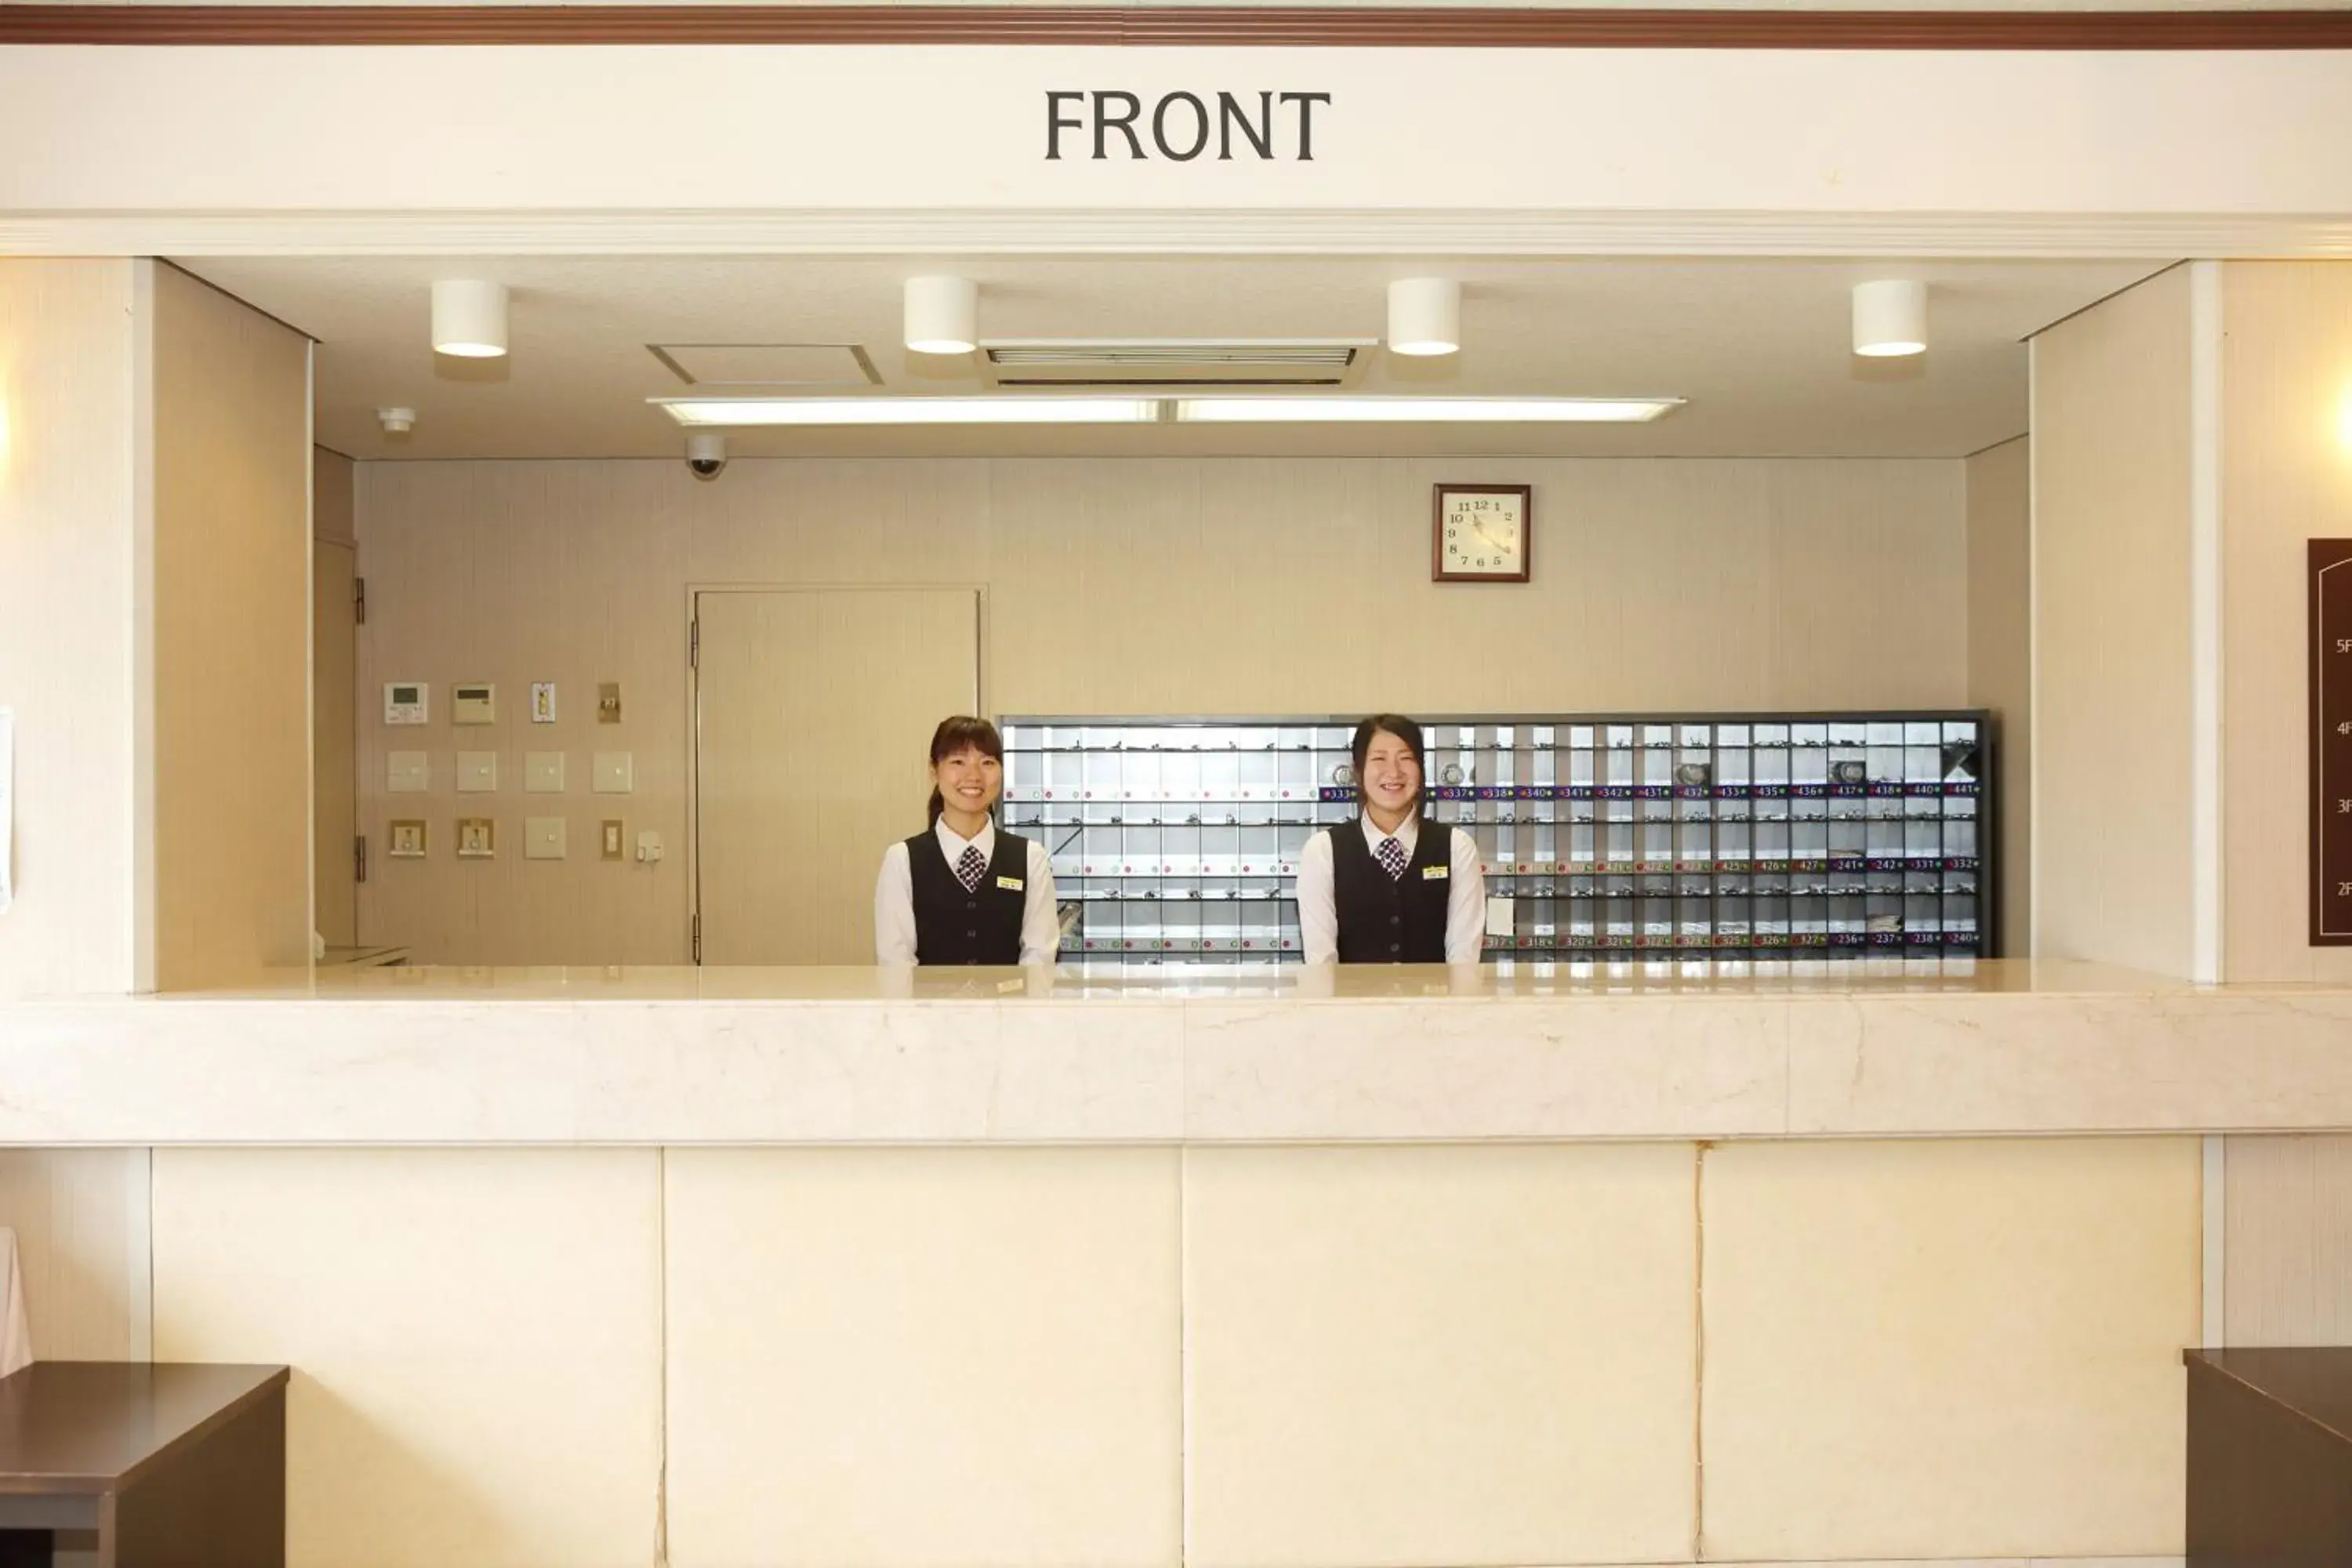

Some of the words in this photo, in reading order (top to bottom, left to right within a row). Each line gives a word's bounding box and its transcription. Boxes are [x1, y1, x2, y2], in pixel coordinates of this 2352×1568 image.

[1044, 90, 1331, 162] FRONT
[1458, 502, 1471, 511] 11
[1474, 500, 1488, 510] 12
[1494, 502, 1500, 511] 1
[1450, 514, 1463, 524] 10
[1461, 556, 1468, 565] 7
[1494, 556, 1502, 565] 5
[2336, 639, 2352, 653] 5F
[2337, 721, 2352, 735] 4F
[1448, 789, 1467, 797] 337
[1488, 789, 1507, 797] 338
[1527, 789, 1546, 797] 340
[1565, 788, 1583, 797] 341
[1603, 788, 1622, 797] 342
[1644, 788, 1661, 797] 431
[1683, 788, 1702, 797] 432
[1759, 787, 1777, 796] 435
[1798, 786, 1817, 795] 436
[1914, 786, 1933, 794] 440
[2338, 799, 2352, 813] 3F
[1800, 861, 1817, 869] 427
[1838, 861, 1856, 869] 241
[1876, 860, 1895, 869] 242
[1915, 860, 1933, 869] 331
[1954, 859, 1972, 868] 332
[2338, 882, 2352, 895] 2F
[1528, 938, 1545, 946] 318
[1567, 937, 1584, 946] 320
[1606, 937, 1622, 946] 321
[1875, 935, 1894, 943] 237
[1915, 935, 1933, 943] 238
[1952, 934, 1972, 942] 240
